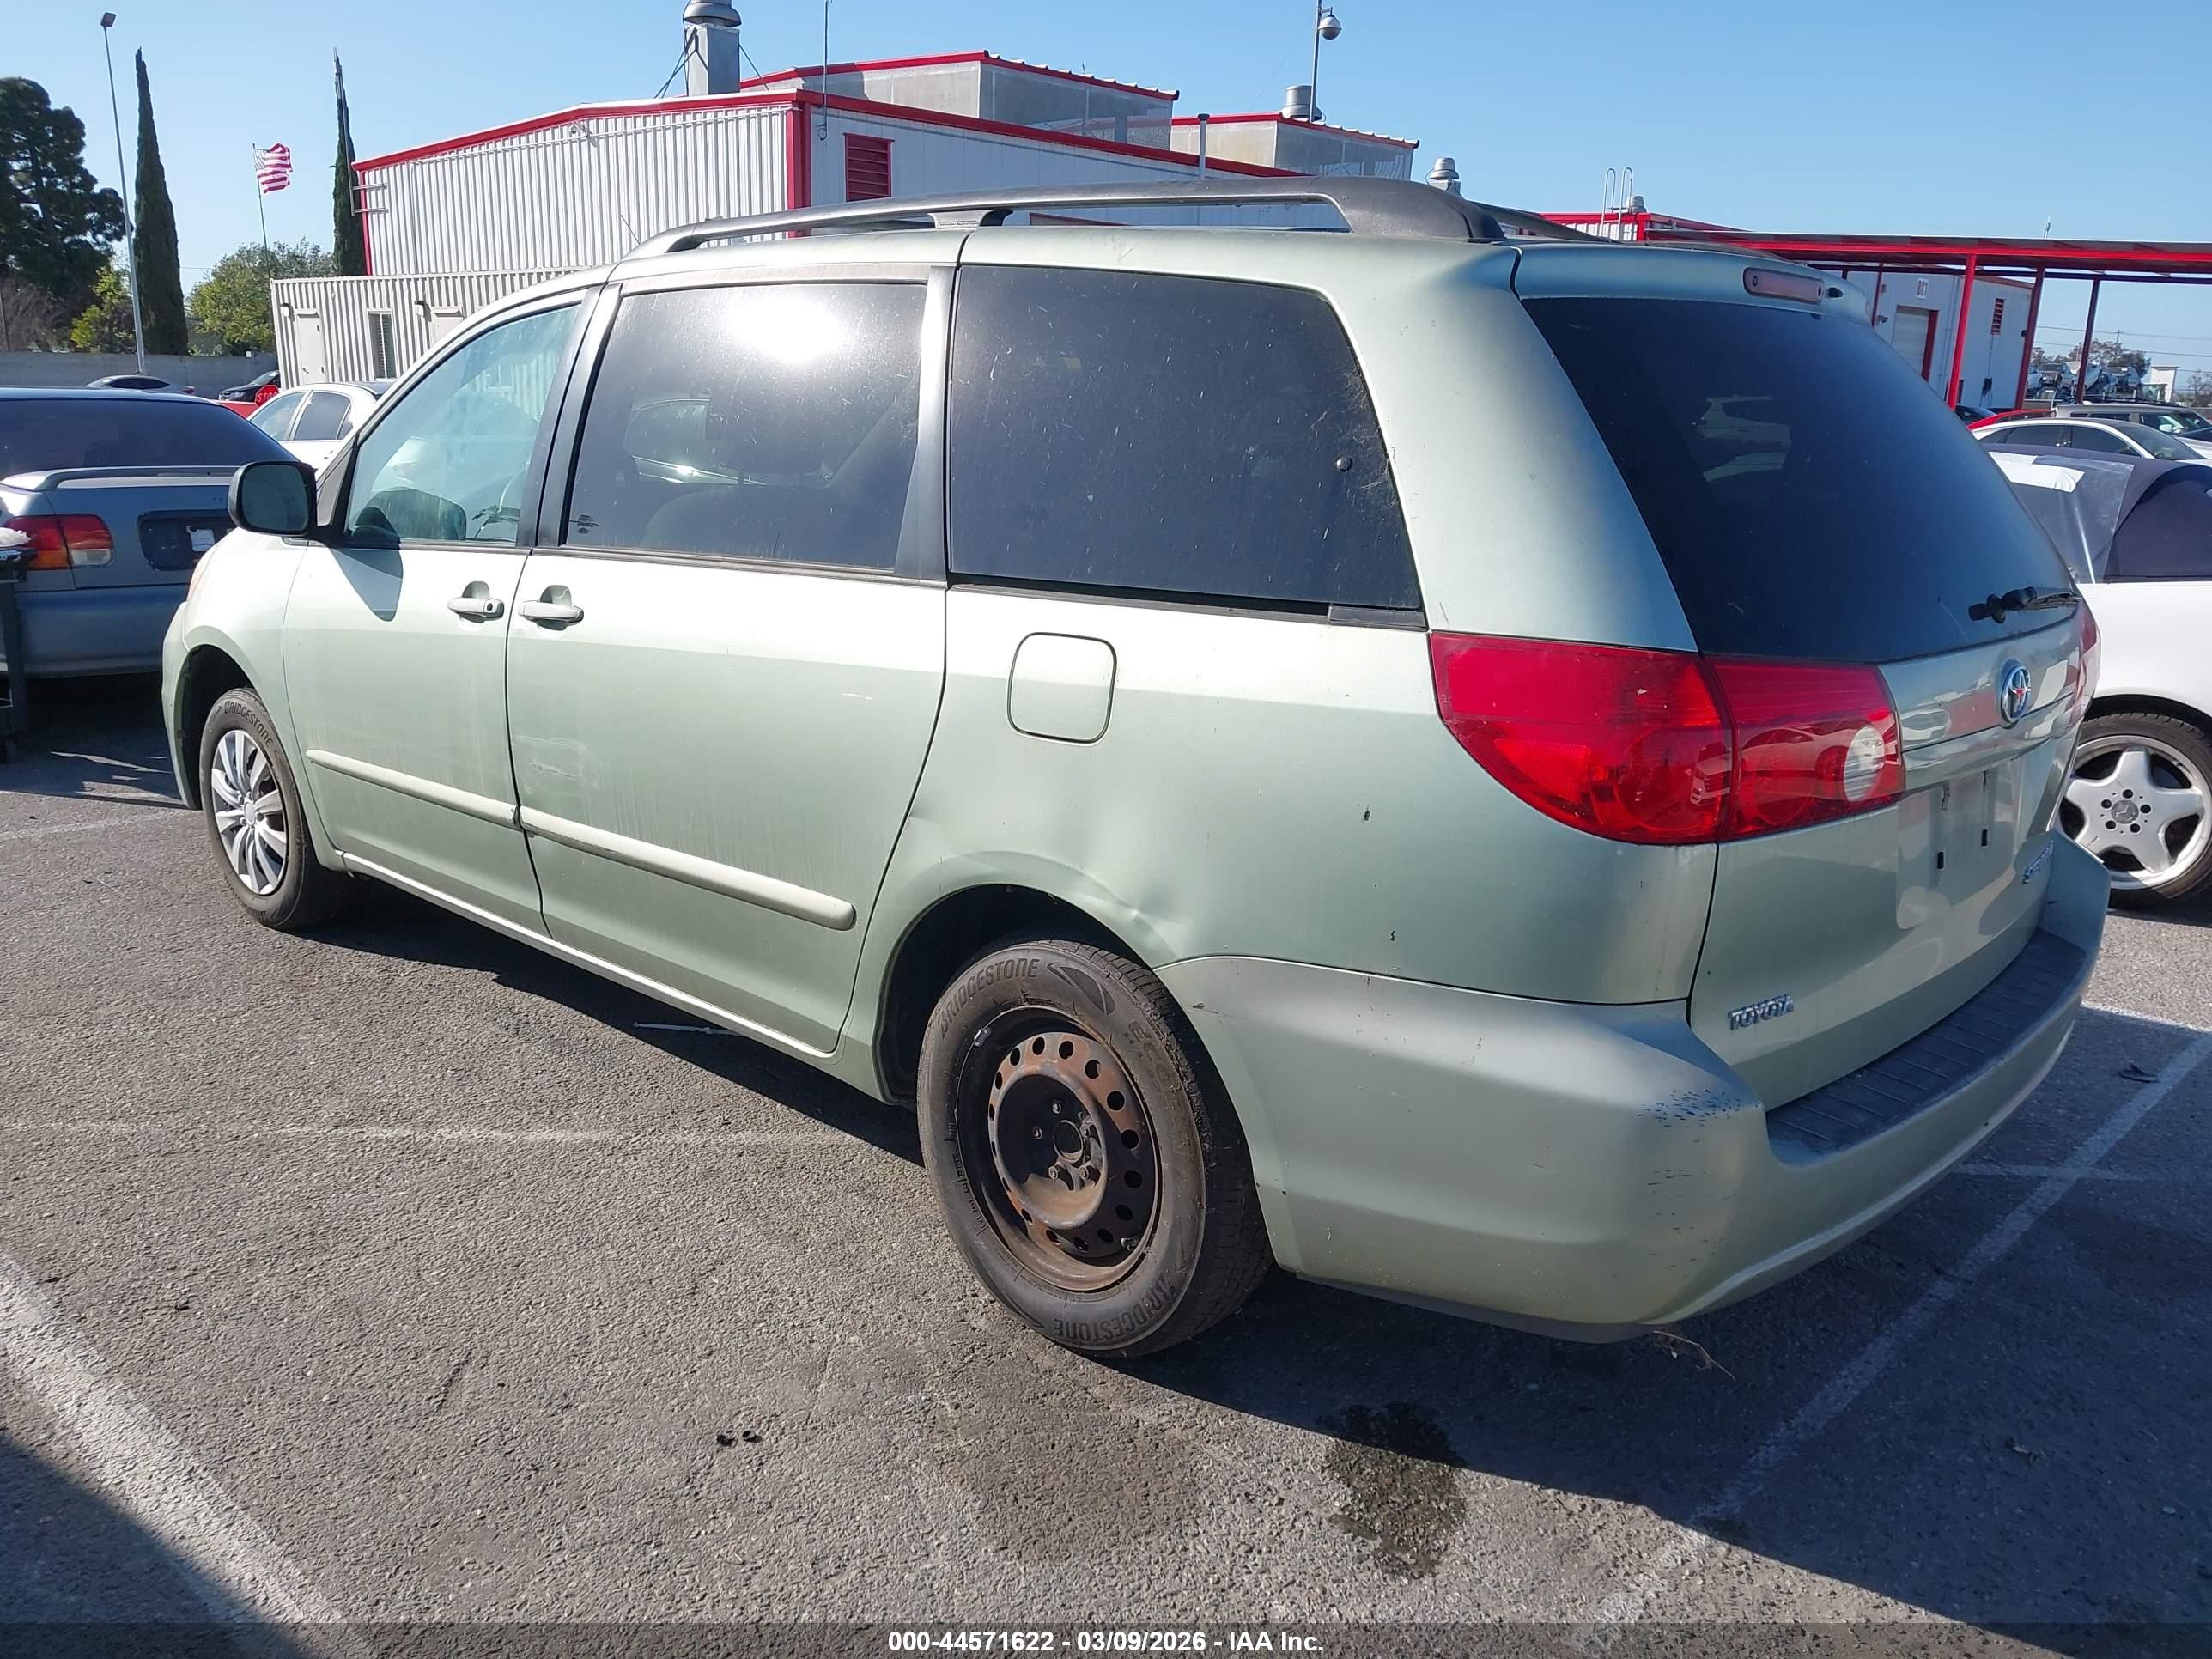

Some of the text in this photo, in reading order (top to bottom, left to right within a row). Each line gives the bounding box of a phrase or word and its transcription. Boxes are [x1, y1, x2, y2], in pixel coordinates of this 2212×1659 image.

[224, 700, 273, 748] BRIDGESTONE
[937, 957, 1040, 1040] BRIDGESTONE
[1727, 994, 1794, 1031] TOYOTA
[1053, 1272, 1179, 1340] BRIDGESTONE
